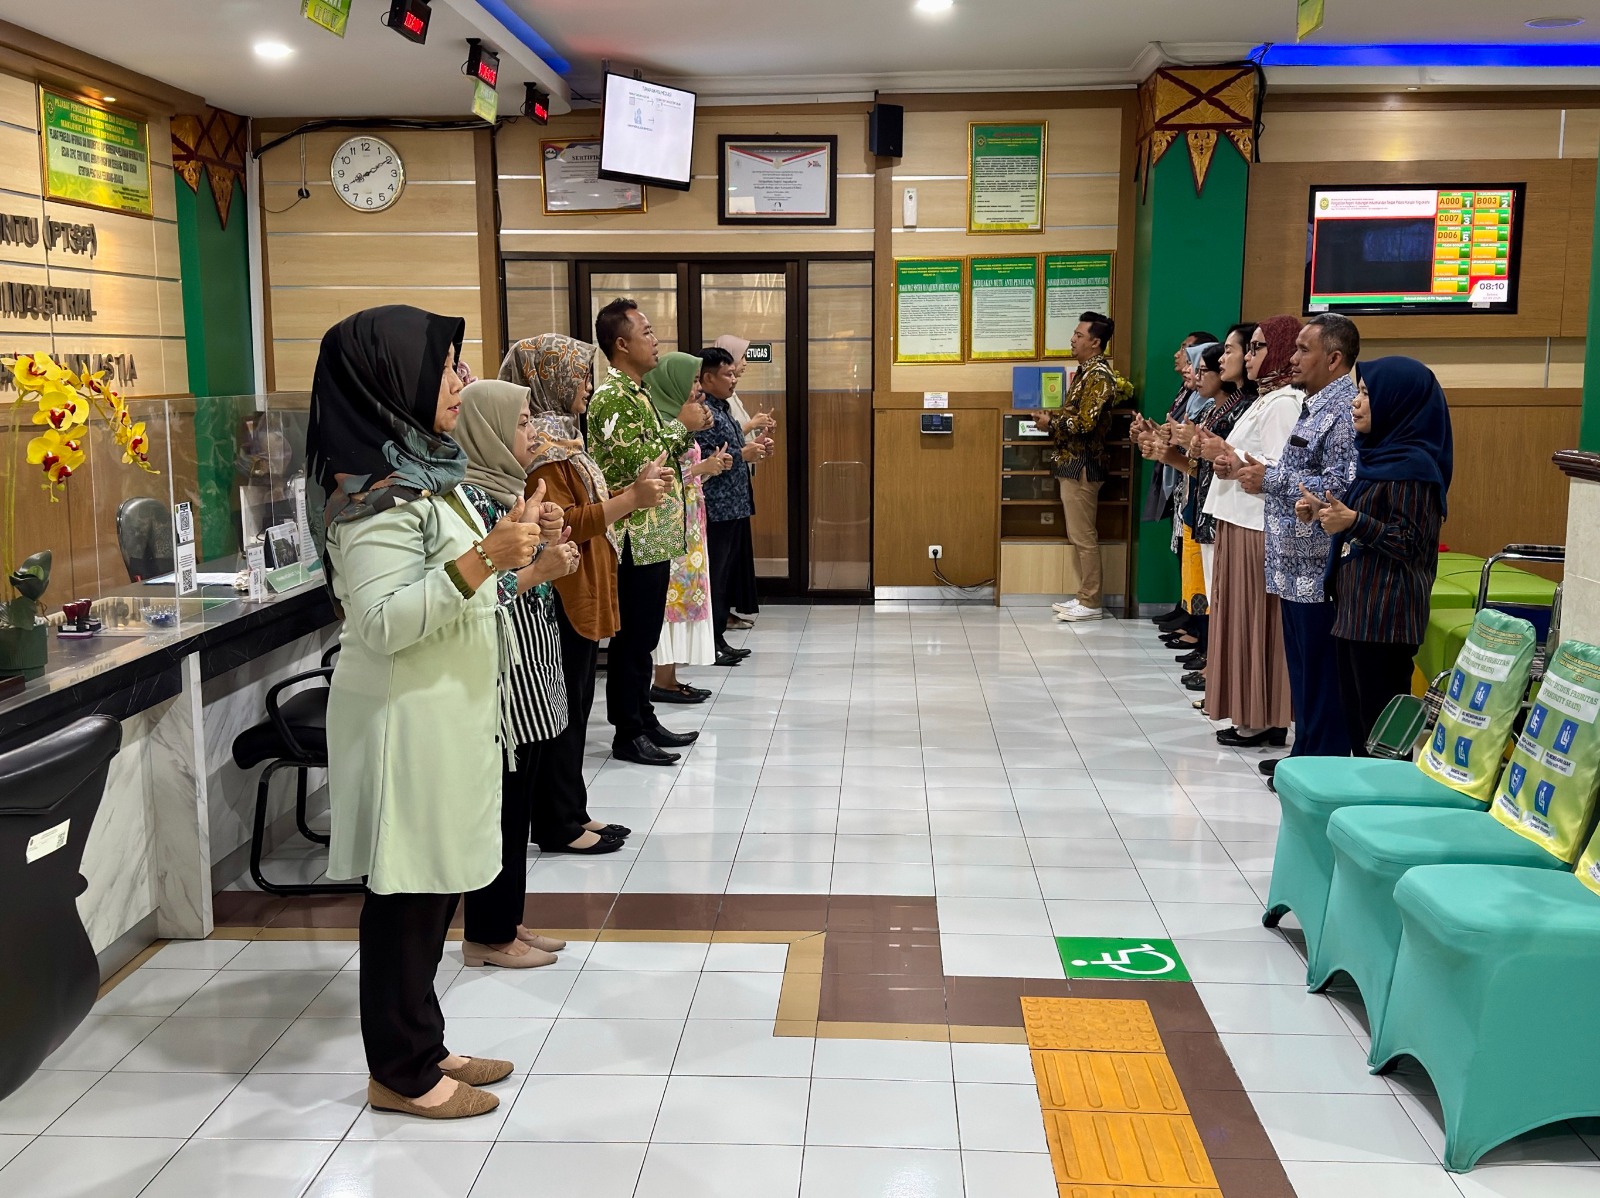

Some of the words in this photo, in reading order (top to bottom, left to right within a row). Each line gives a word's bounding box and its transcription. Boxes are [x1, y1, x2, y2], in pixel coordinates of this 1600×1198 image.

[361, 143, 370, 151] 12
[386, 156, 392, 164] 2
[353, 193, 358, 201] 7
[366, 197, 373, 205] 6
[379, 193, 385, 201] 5
[0, 213, 39, 248] NTU
[42, 215, 98, 260] (PTSP)
[747, 348, 768, 358] ETUGAS
